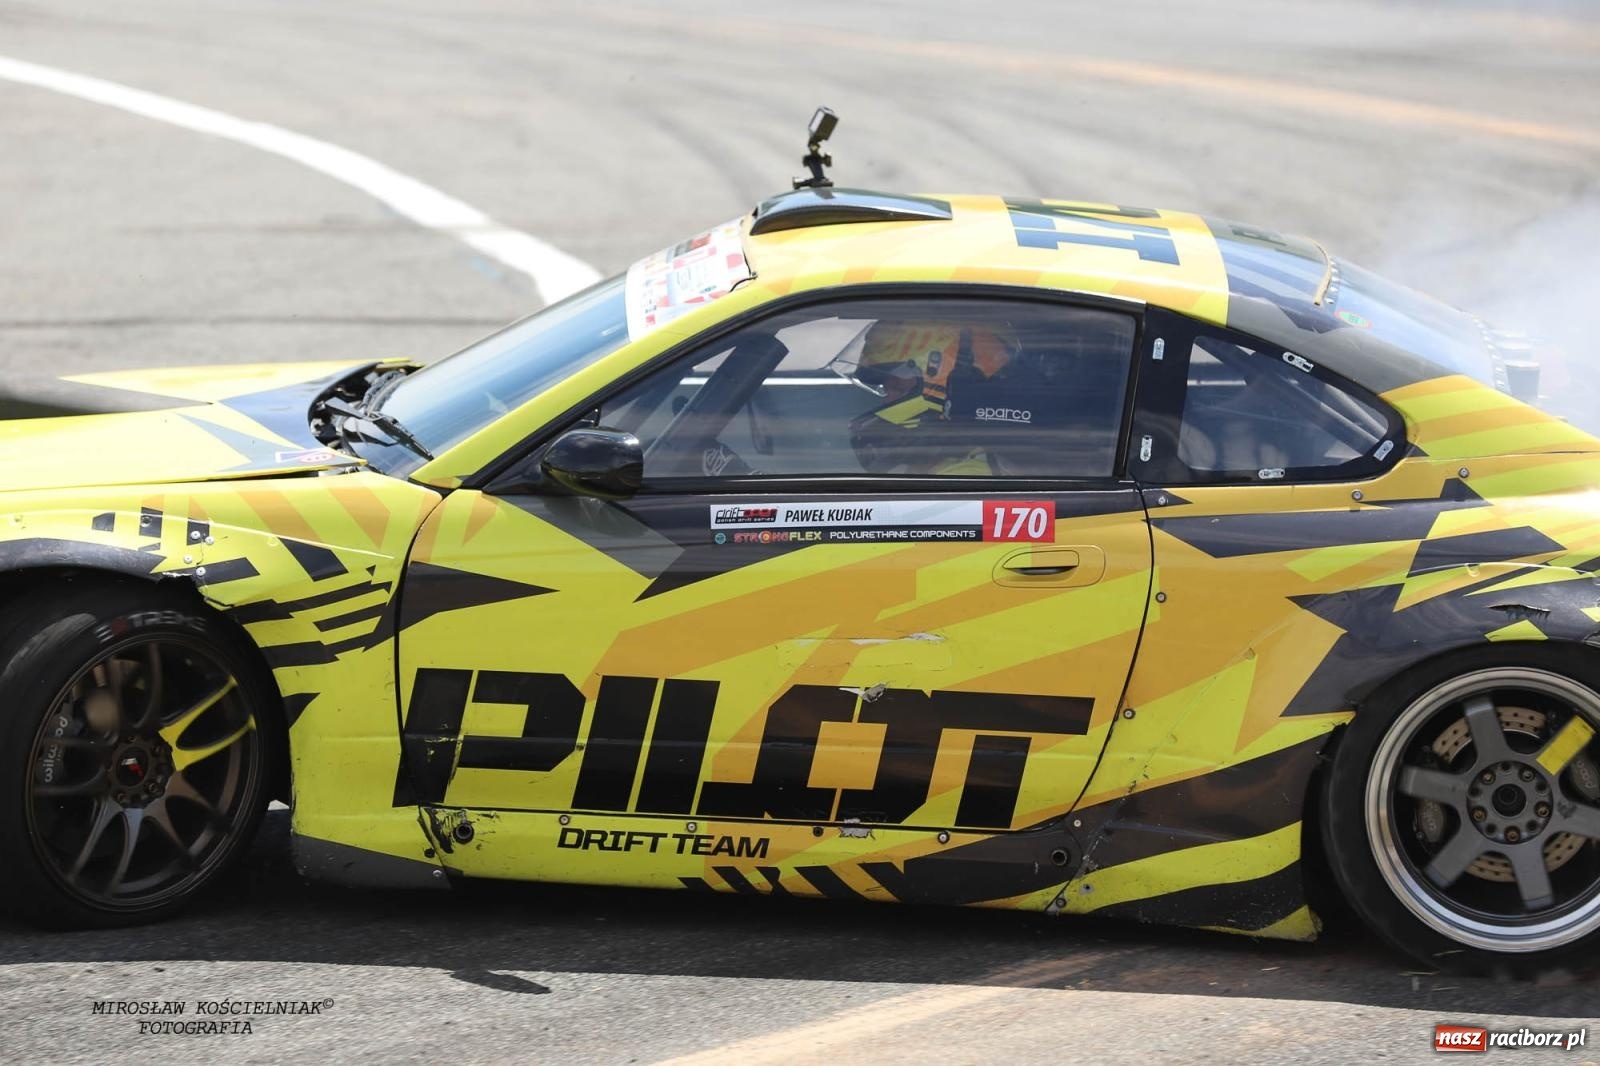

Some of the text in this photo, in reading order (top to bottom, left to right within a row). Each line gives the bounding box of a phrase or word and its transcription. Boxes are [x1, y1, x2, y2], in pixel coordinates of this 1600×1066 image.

[975, 407, 1031, 422] sparco
[784, 509, 825, 523] PAWEŁ
[827, 508, 874, 522] KUBIAK
[992, 507, 1048, 538] 170
[829, 530, 908, 540] POLYURETHANE
[910, 530, 976, 539] COMPONENTS
[393, 667, 1095, 829] PILOT
[557, 827, 770, 859] DRIFT TEAM
